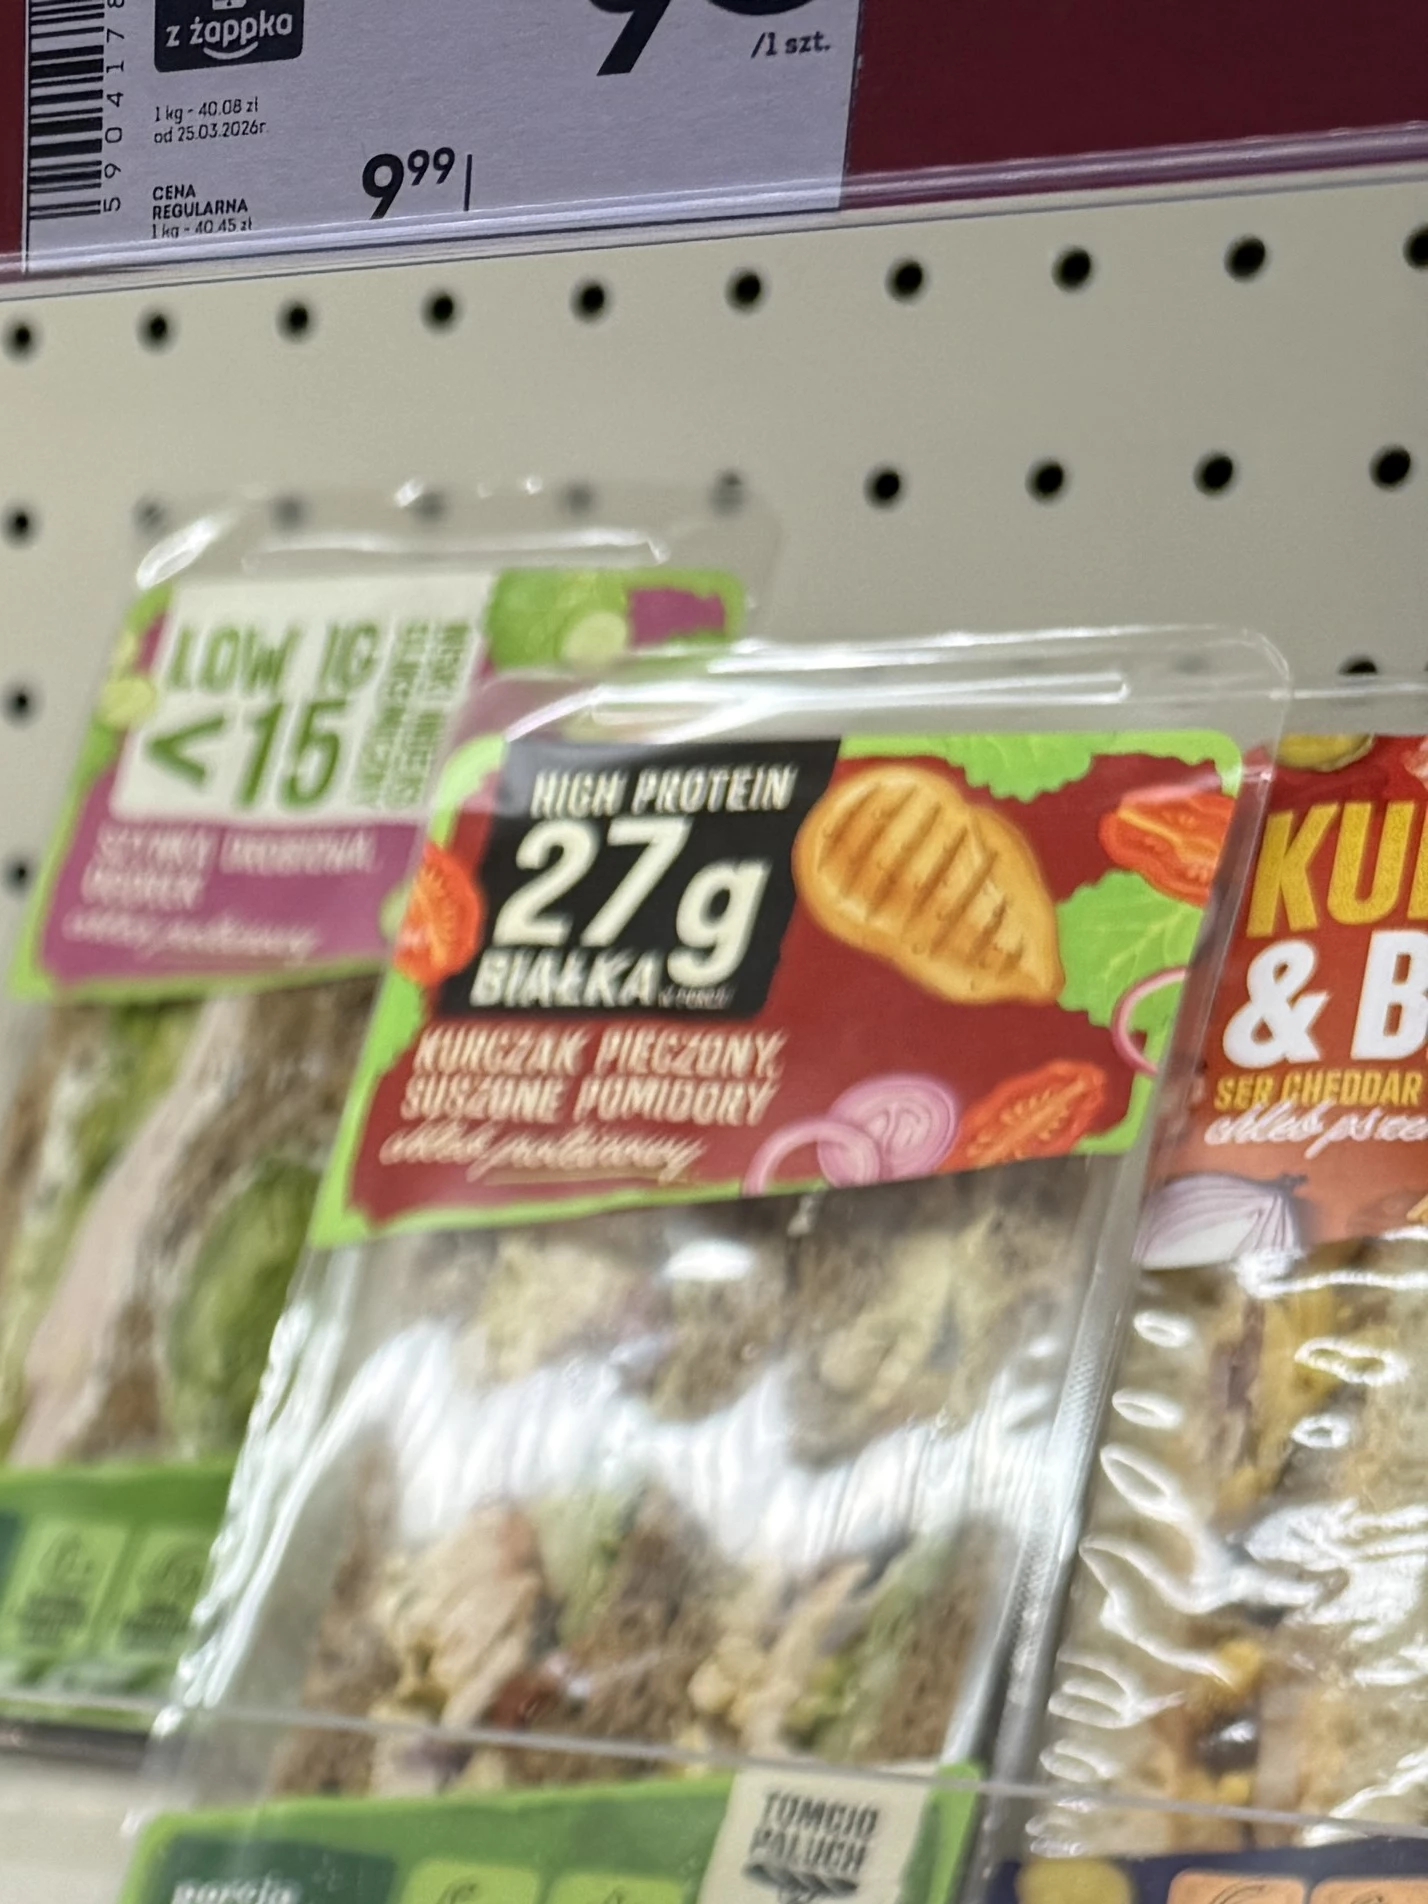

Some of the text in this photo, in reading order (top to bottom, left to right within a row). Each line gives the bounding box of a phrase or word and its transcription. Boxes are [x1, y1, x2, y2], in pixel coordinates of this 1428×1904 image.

[190, 10, 293, 48] żappka
[154, 128, 173, 144] od
[165, 105, 184, 124] kg
[152, 184, 196, 201] CENA
[152, 199, 249, 220] REGULARNA
[632, 762, 800, 816] PROTEIN
[492, 815, 774, 988] 27g
[469, 948, 662, 1008] BIAŁKA
[412, 1026, 590, 1077] KURCZAK
[400, 1076, 780, 1127] SUSZONE POMIDORY
[1214, 1068, 1424, 1110] SER CHEDDAR
[763, 1790, 880, 1838] TOMCIO
